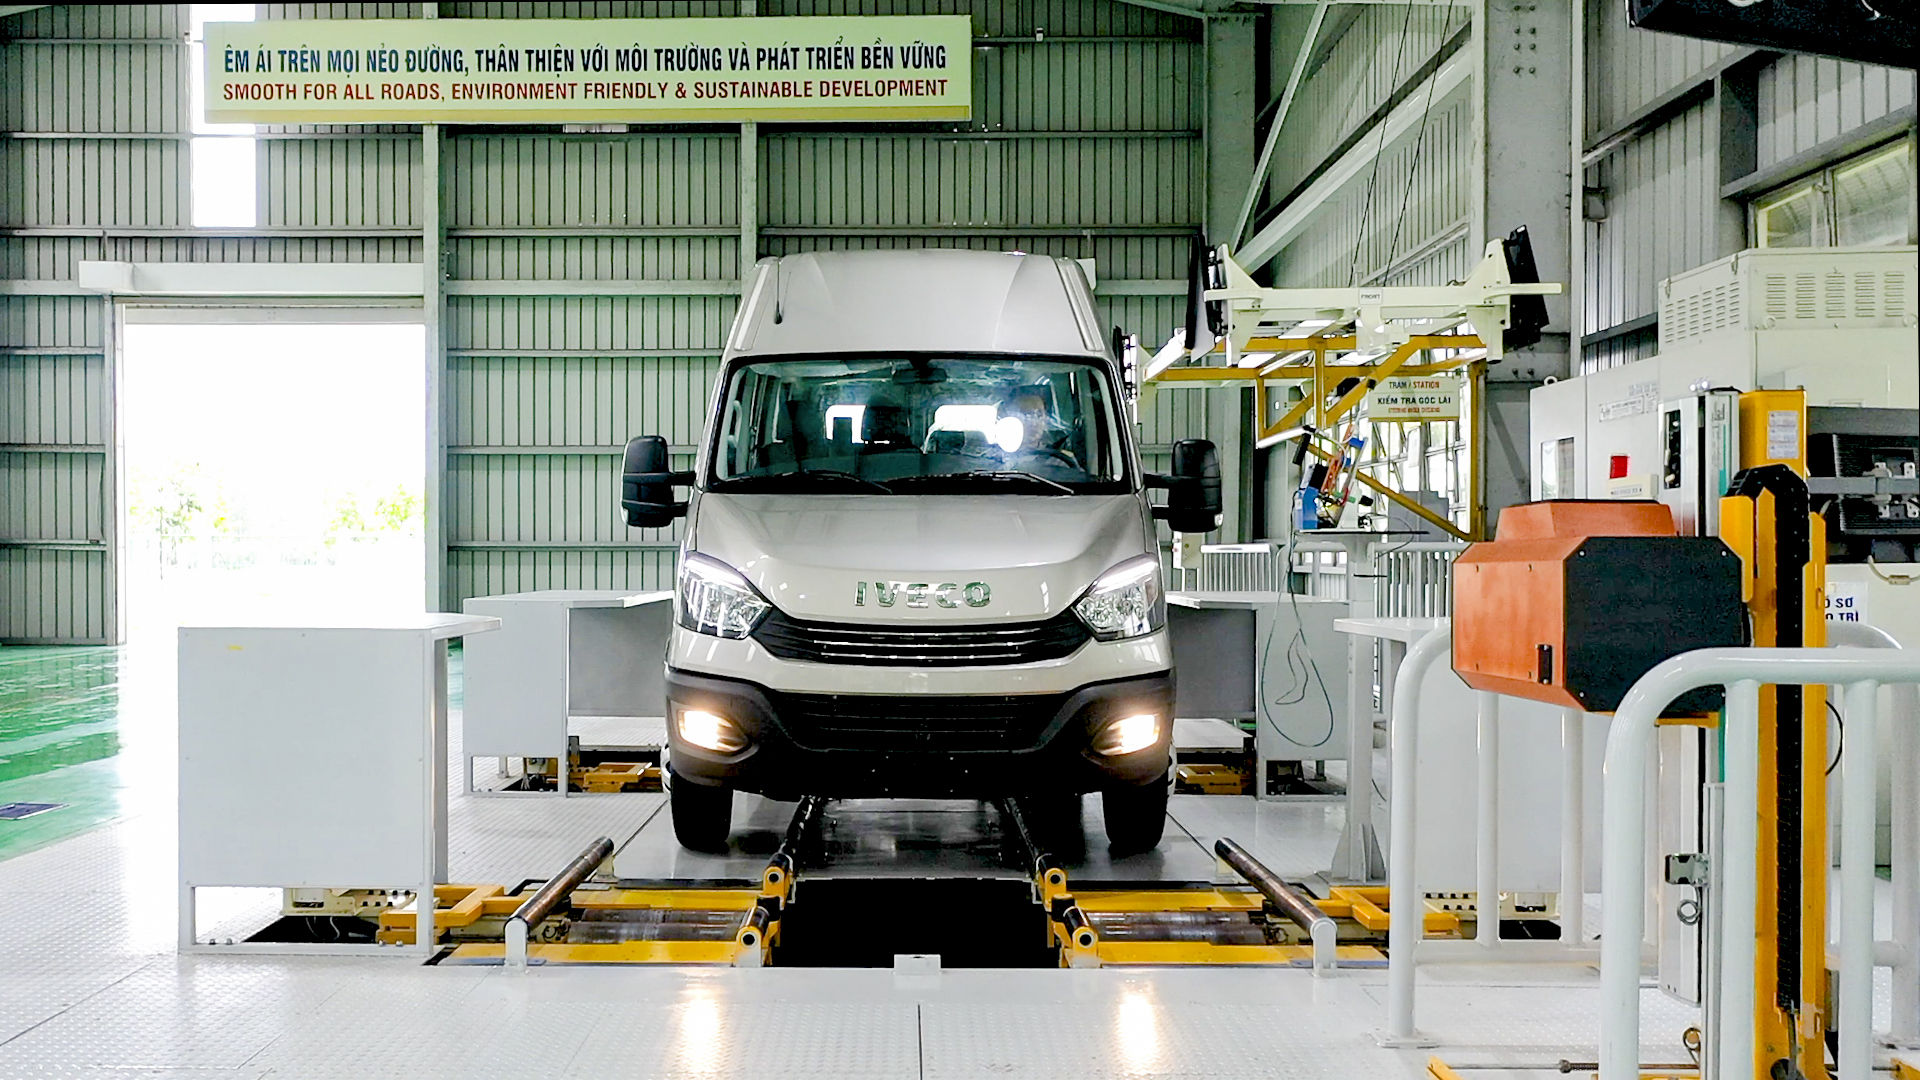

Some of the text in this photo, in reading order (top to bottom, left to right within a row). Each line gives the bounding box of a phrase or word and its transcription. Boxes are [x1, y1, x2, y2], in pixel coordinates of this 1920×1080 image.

[224, 35, 946, 79] ÊM ÁI TRÊN MỌI NẺO ĐƯỜNG, THÂN THIỆN VỚI MÔI TRƯỜNG VÀ PHÁT TRIỂN BỀN VỮNG
[223, 79, 948, 102] SMOOTH FOR ALL ROADS, ENVIRONMENT FRIENDLY & SUSTAINABLE DEVELOPMENT
[1413, 381, 1440, 389] STATION
[1400, 397, 1417, 405] TRA
[855, 581, 991, 608] IVECO
